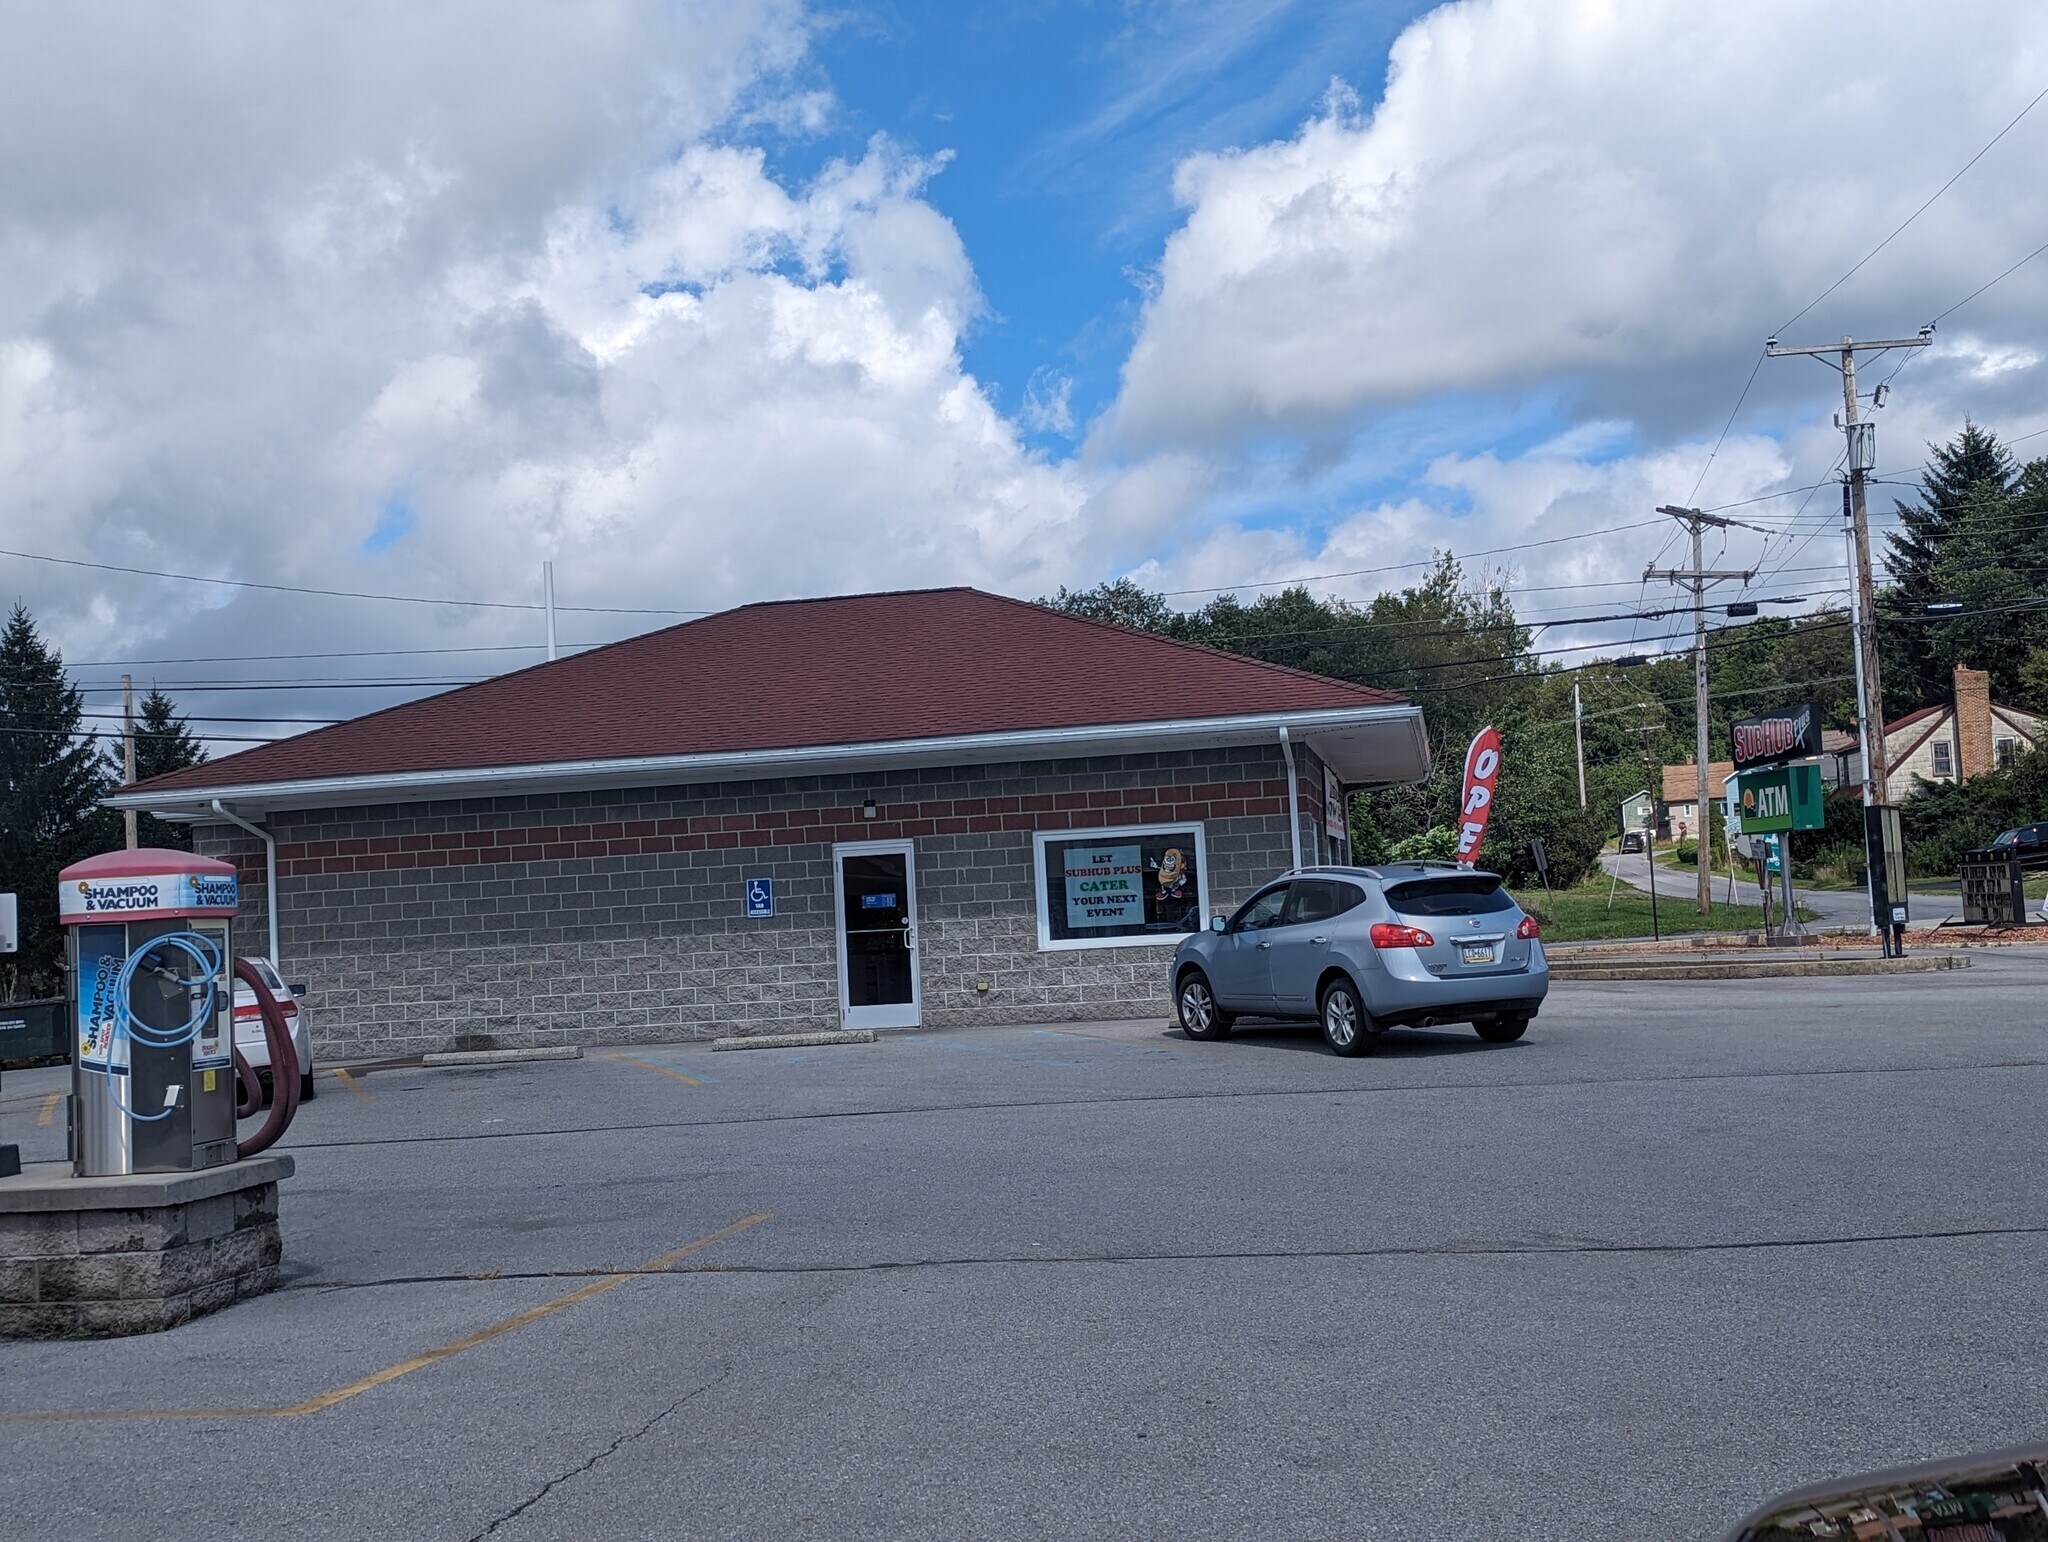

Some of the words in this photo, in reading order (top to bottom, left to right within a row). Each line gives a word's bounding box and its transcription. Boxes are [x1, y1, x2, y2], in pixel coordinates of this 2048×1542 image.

[1733, 718, 1794, 763] SUBHUB
[1758, 785, 1789, 818] ATM
[1092, 855, 1113, 864] LET
[1065, 868, 1111, 877] SUBHUB
[1113, 866, 1141, 875] PLUS
[84, 884, 158, 900] SHAMPOO
[194, 882, 236, 895] SHAMPOO
[1079, 880, 1129, 892] CATER
[86, 900, 96, 911] &
[97, 897, 158, 910] VACUUM
[196, 895, 204, 905] &
[203, 894, 236, 906] VACUUM
[1072, 896, 1104, 905] YOUR
[1107, 895, 1137, 904] NEXT
[1087, 908, 1124, 917] EVENT
[87, 969, 108, 1049] SHAMPOO
[99, 954, 112, 967] &
